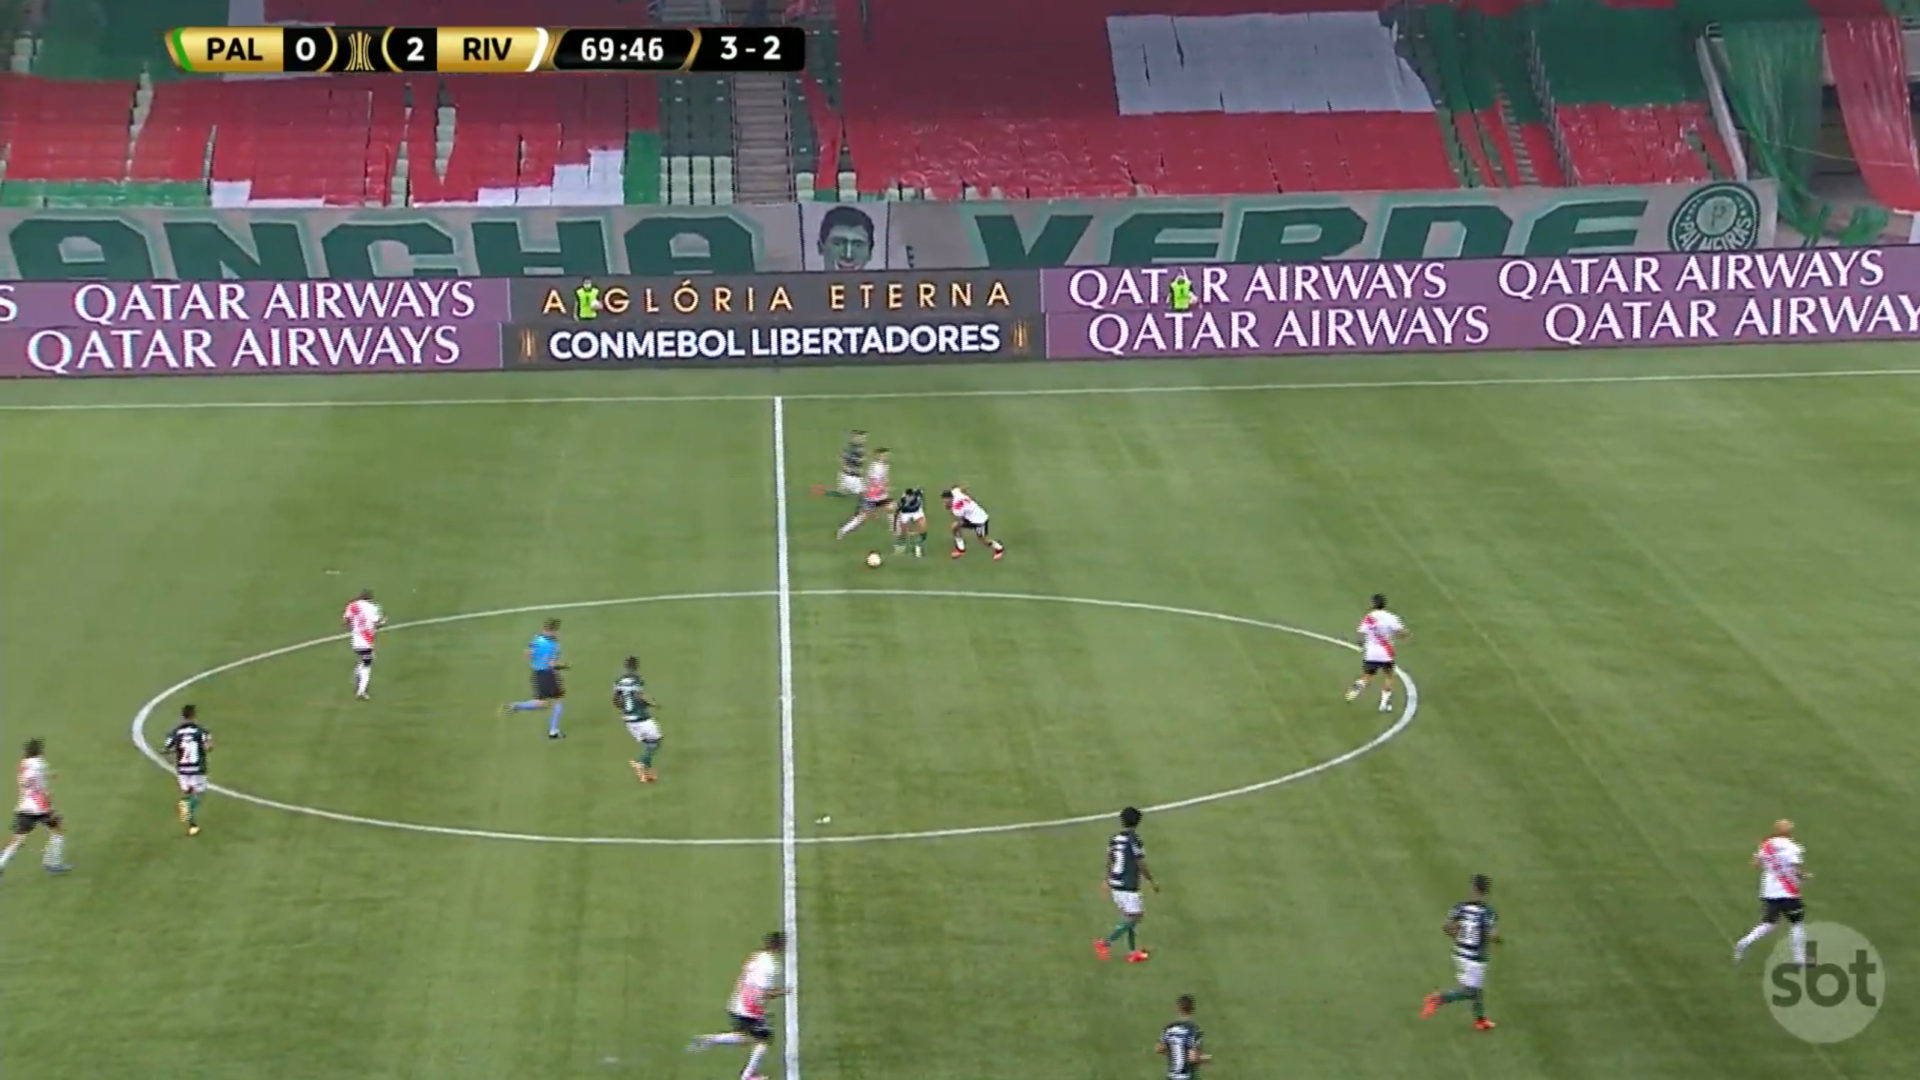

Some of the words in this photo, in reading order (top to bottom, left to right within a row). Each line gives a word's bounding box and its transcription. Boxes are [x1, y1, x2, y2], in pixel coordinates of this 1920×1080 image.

[543, 287, 567, 315] A
[604, 279, 793, 314] GLÓRIA
[830, 282, 1011, 310] ETERNA
[1069, 267, 1230, 309] QATR
[1244, 262, 1447, 302] AIRWAYS
[1499, 257, 1661, 300] QATAR
[1675, 250, 1884, 292] AIRWAYS
[74, 284, 250, 325] QATAR
[263, 281, 476, 321] AIRWAYS
[1545, 300, 1719, 345] QATAR
[27, 328, 216, 374] QATAR
[232, 325, 460, 370] AIRWAYS
[550, 328, 746, 361] CONMEBOL
[752, 324, 1000, 357] LIBERTADORES
[1089, 311, 1259, 355] QATAR
[1274, 306, 1489, 348] AIRWAYS
